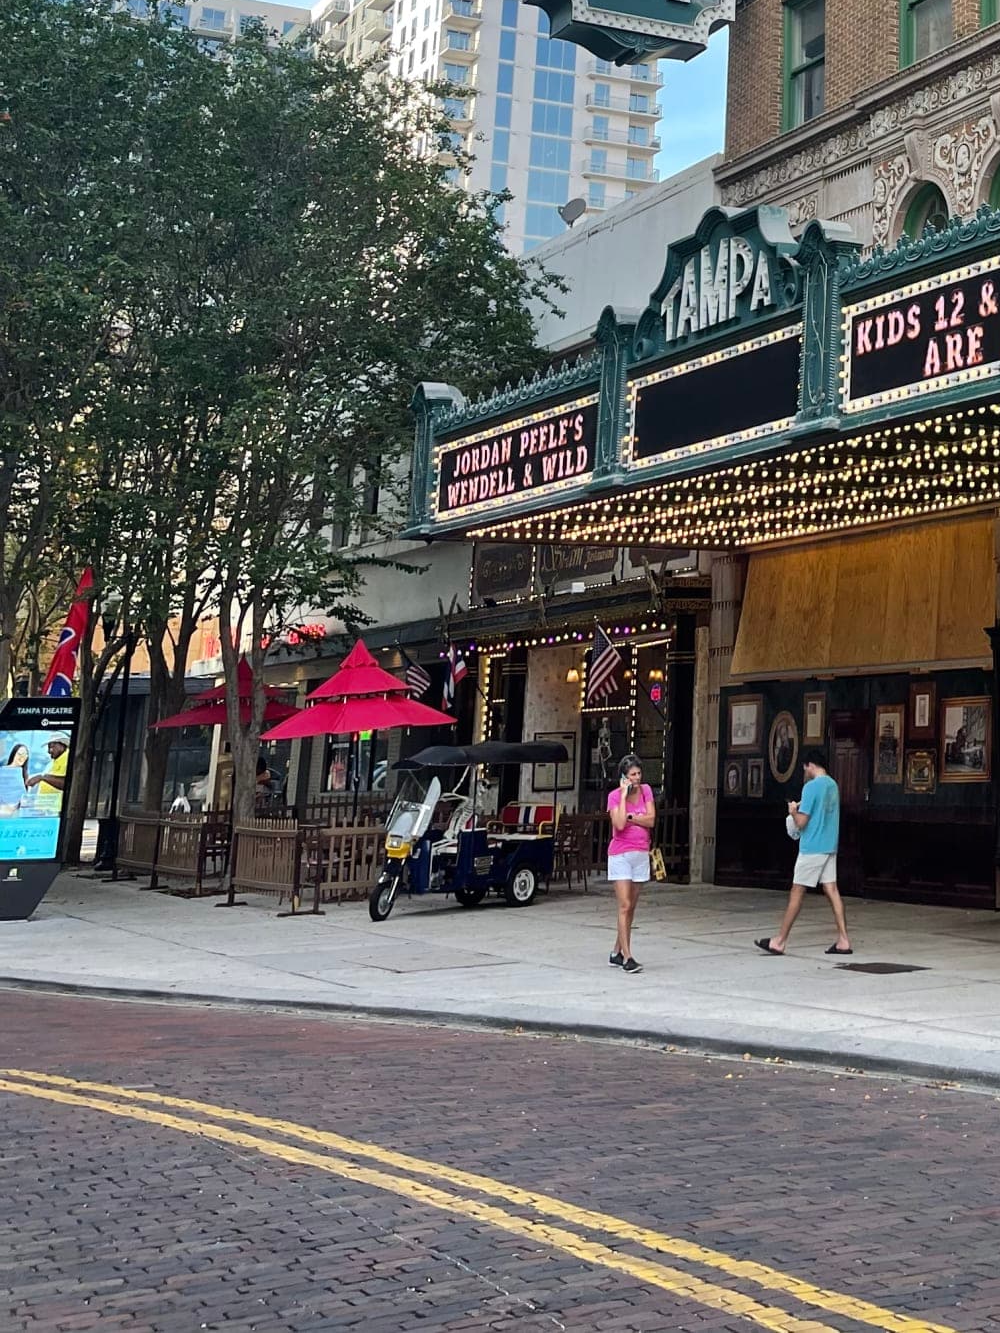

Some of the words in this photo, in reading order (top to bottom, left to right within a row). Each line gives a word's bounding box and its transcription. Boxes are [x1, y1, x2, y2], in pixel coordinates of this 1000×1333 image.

[661, 236, 772, 342] TAMPA
[855, 303, 921, 356] KIDS
[934, 288, 964, 332] 12
[978, 280, 998, 317] &
[922, 326, 984, 377] ARE
[447, 467, 515, 508] WENDELL
[523, 463, 533, 487] &
[542, 446, 588, 482] WILD
[453, 436, 512, 477] JORDAN
[519, 414, 584, 458] PEELE'S
